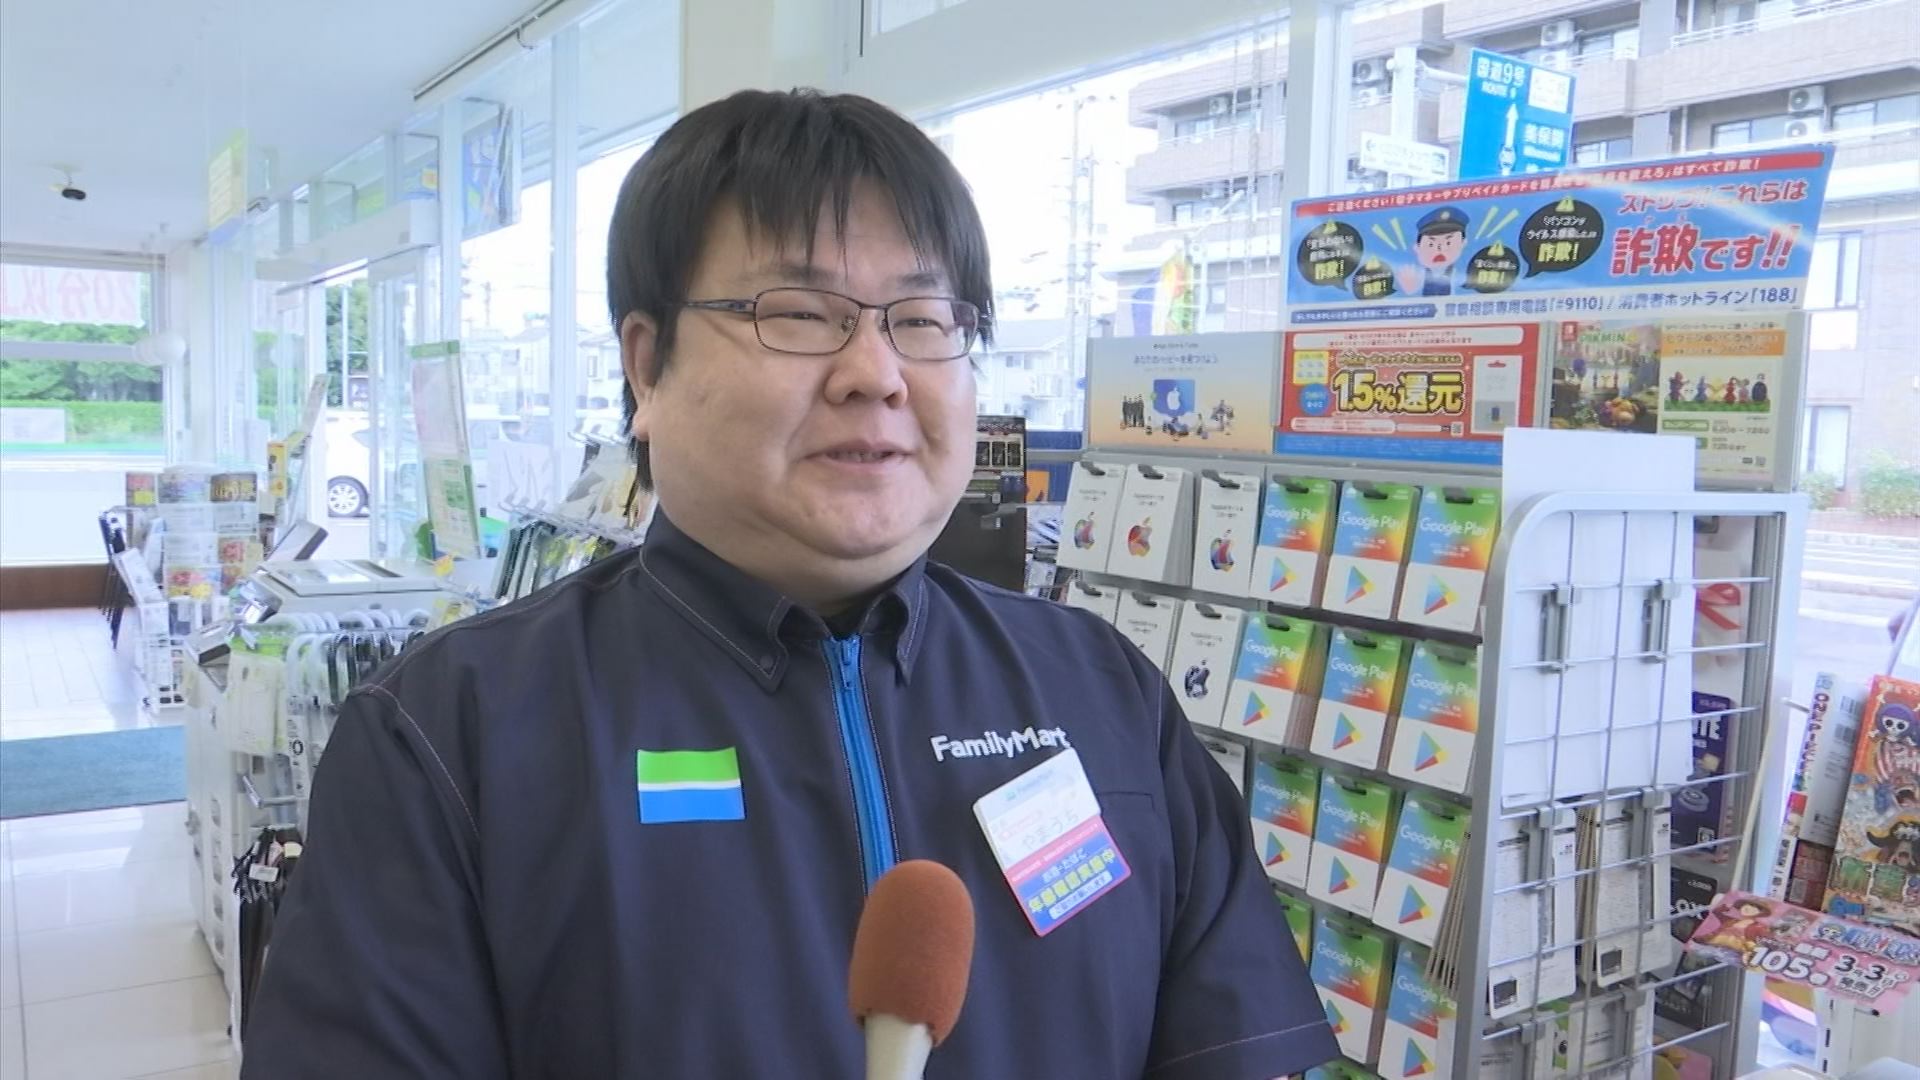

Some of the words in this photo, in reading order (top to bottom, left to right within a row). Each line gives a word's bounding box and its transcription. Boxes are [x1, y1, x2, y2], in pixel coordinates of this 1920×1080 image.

[1265, 506, 1300, 522] Google
[1341, 514, 1378, 530] Google
[1380, 516, 1405, 531] Play
[1419, 519, 1463, 535] Google
[1464, 521, 1490, 537] Play
[1246, 639, 1278, 658] Google
[1330, 656, 1368, 677] Google
[1411, 676, 1455, 695] Google
[930, 726, 1071, 762] FamilyMart
[1256, 780, 1290, 801] Google
[1322, 800, 1358, 821] Google
[1400, 825, 1441, 850] Google
[1317, 943, 1354, 967] Google
[1398, 975, 1439, 1002] Google
